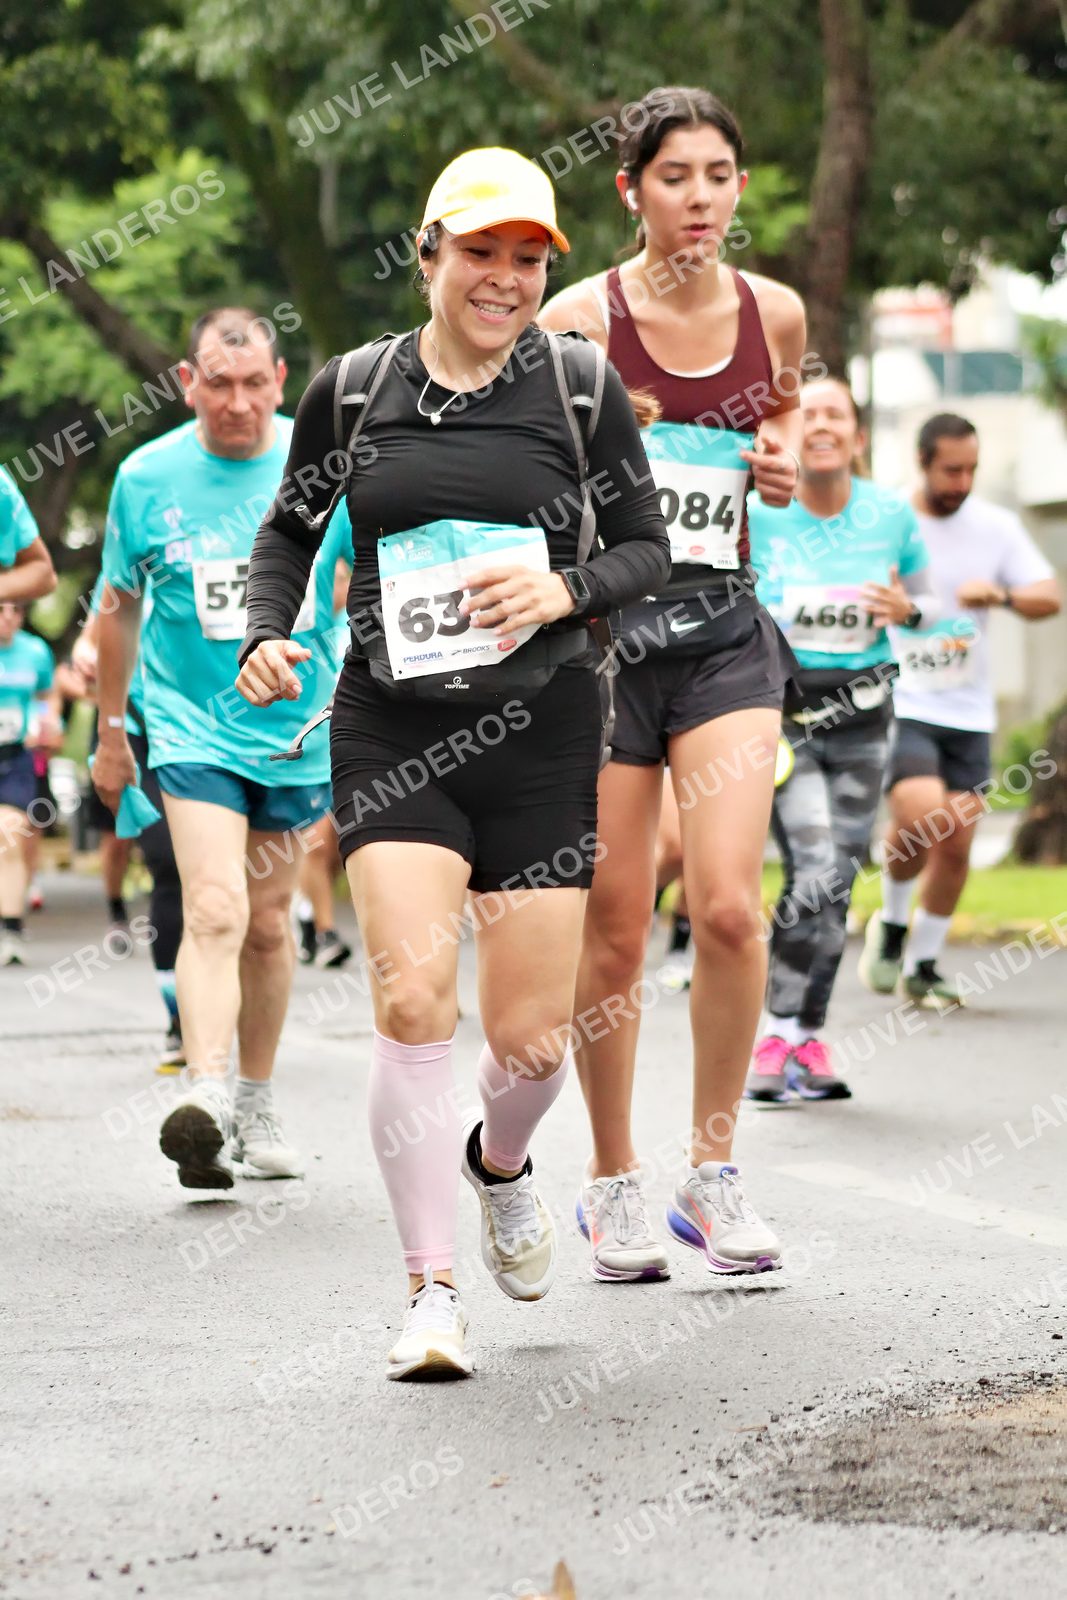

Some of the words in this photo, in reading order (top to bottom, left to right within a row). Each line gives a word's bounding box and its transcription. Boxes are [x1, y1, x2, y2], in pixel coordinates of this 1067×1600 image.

[657, 487, 735, 534] 084
[206, 579, 248, 610] 57
[398, 589, 473, 643] 63
